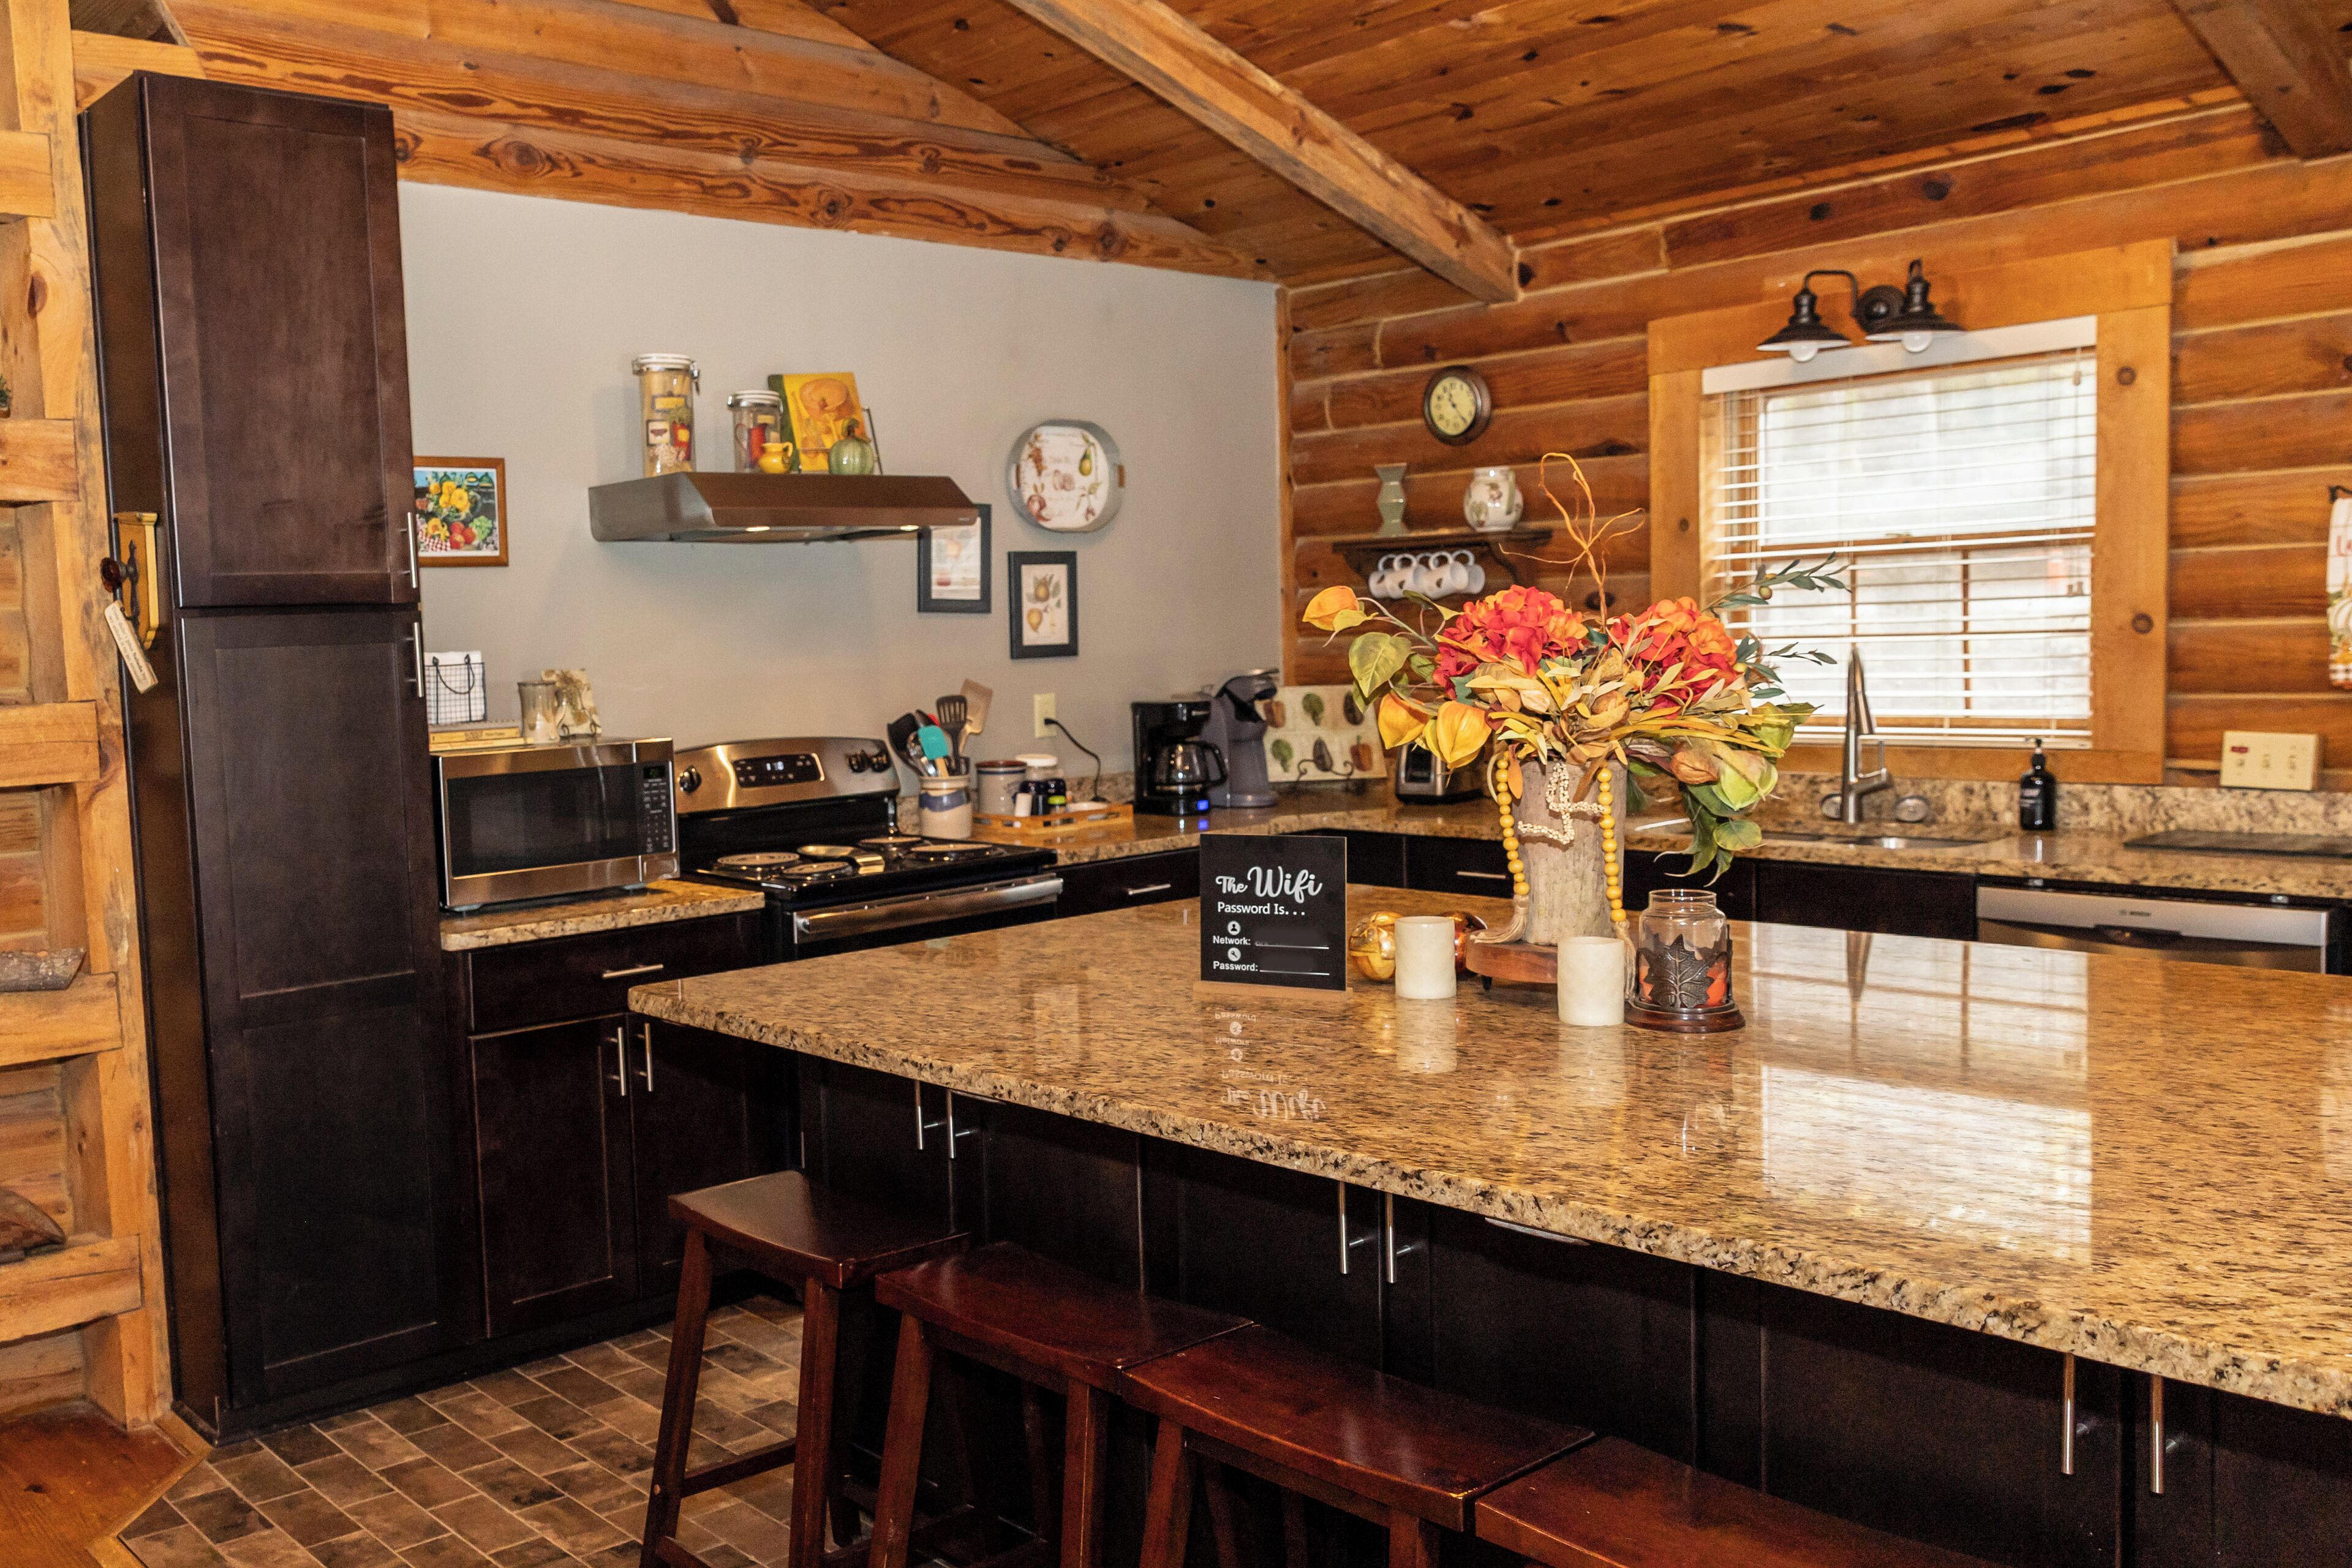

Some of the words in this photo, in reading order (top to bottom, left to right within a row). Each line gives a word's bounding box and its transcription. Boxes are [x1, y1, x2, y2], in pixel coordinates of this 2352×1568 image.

[1216, 875, 1248, 894] The
[1247, 866, 1322, 903] Wifi
[1218, 902, 1270, 914] Password
[1213, 935, 1251, 946] Network:
[1213, 960, 1258, 971] Password:
